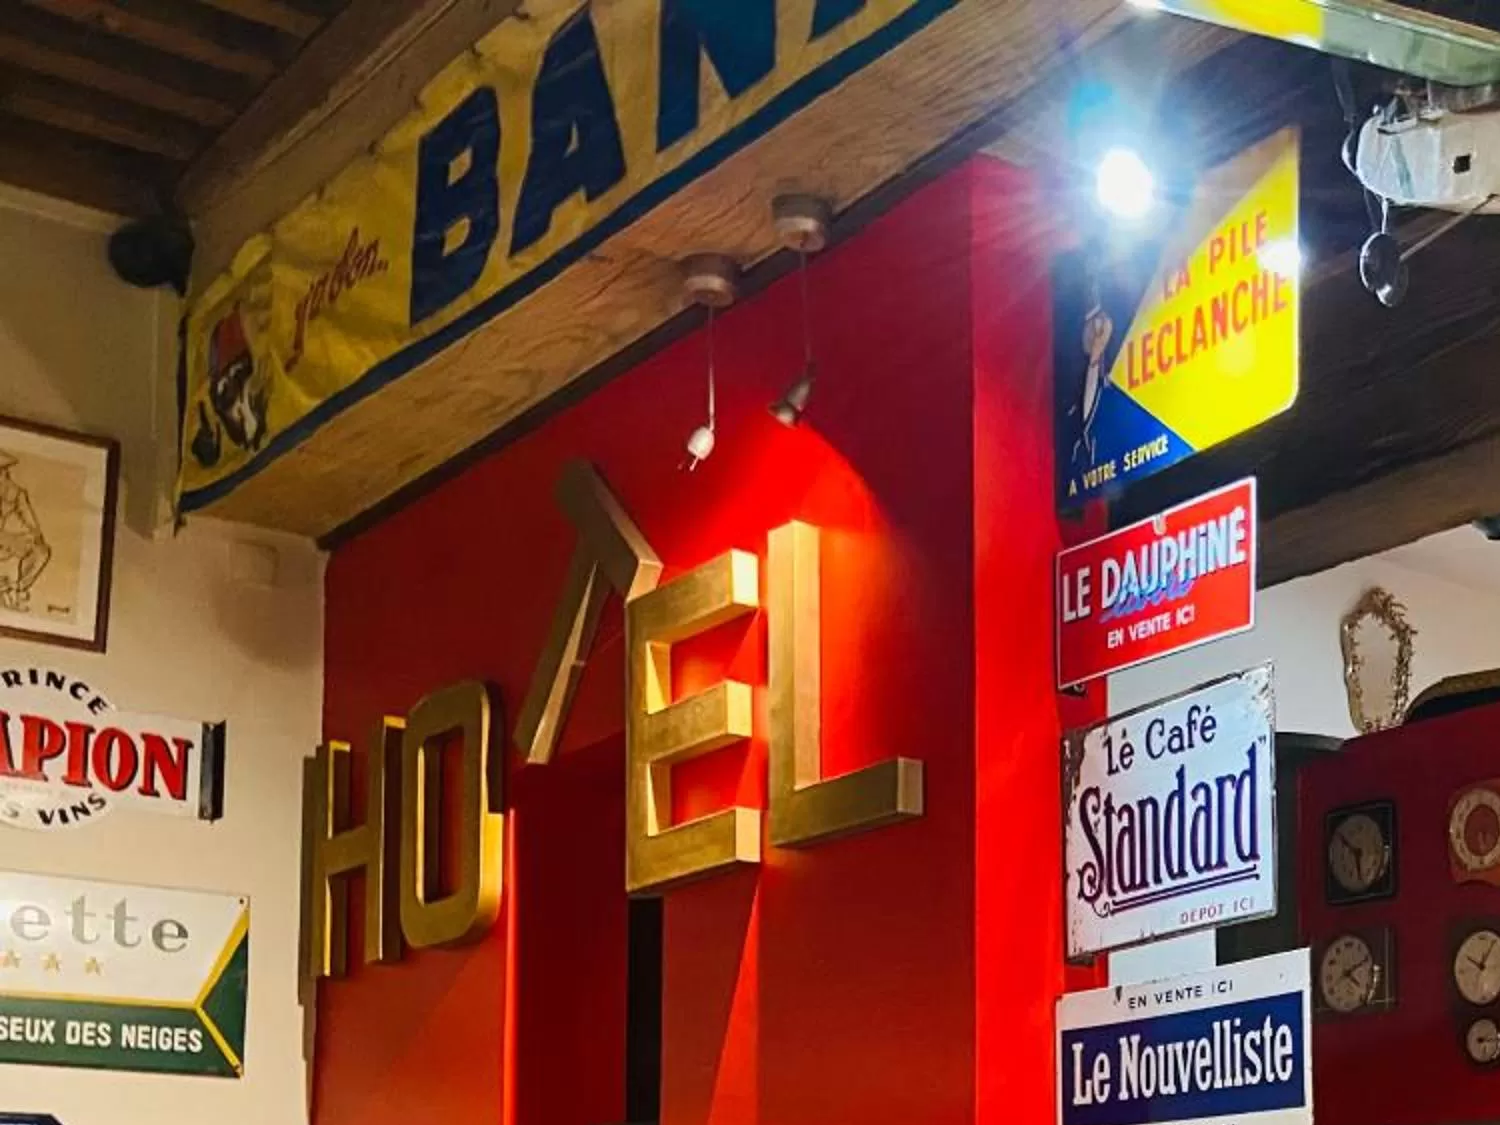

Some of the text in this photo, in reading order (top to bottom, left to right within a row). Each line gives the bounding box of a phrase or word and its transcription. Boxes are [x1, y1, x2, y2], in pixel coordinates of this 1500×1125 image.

[410, 0, 867, 327] BAN
[1208, 208, 1268, 275] PILE
[1082, 460, 1116, 490] VOTRE
[1123, 433, 1170, 471] SERVICE
[1063, 566, 1091, 623] LE
[1107, 604, 1197, 649] EN VENTE ICI
[1146, 704, 1218, 760] Café
[38, 792, 107, 828] VINS
[1128, 980, 1234, 1009] EN VENTE ICI
[66, 1020, 112, 1047] DES
[121, 1024, 203, 1054] NEIGES
[1072, 1014, 1294, 1106] Le Nouvelliste
